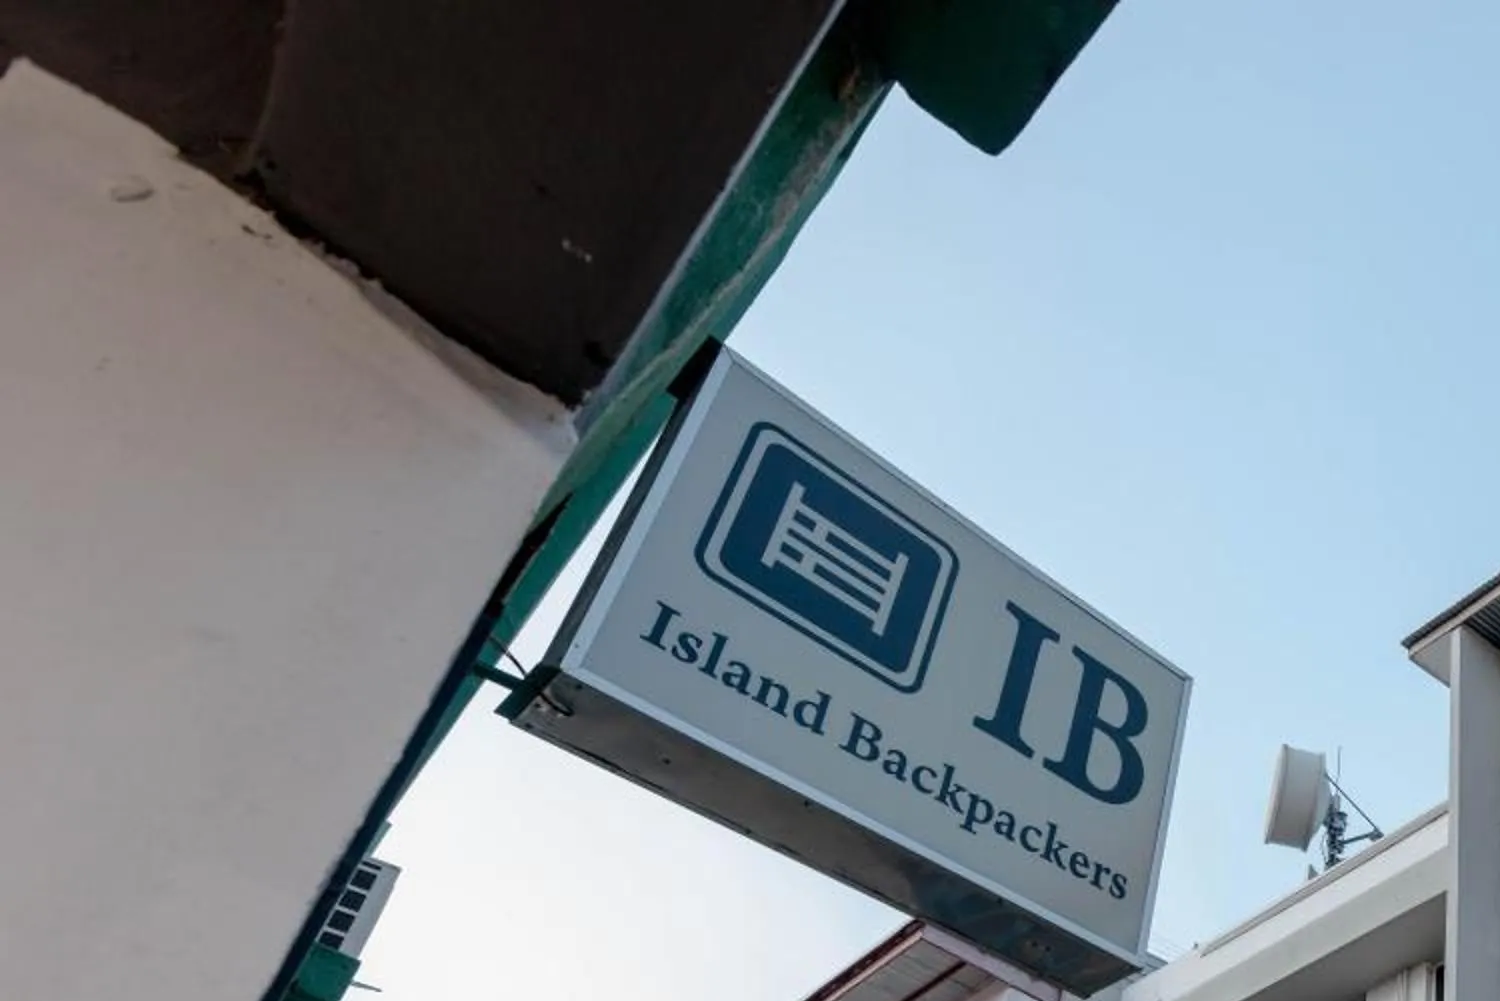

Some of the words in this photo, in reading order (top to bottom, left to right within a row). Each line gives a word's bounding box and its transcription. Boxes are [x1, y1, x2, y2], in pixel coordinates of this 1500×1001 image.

[638, 599, 832, 737] Island
[838, 711, 1129, 901] Backpackers
[972, 599, 1150, 806] IB
